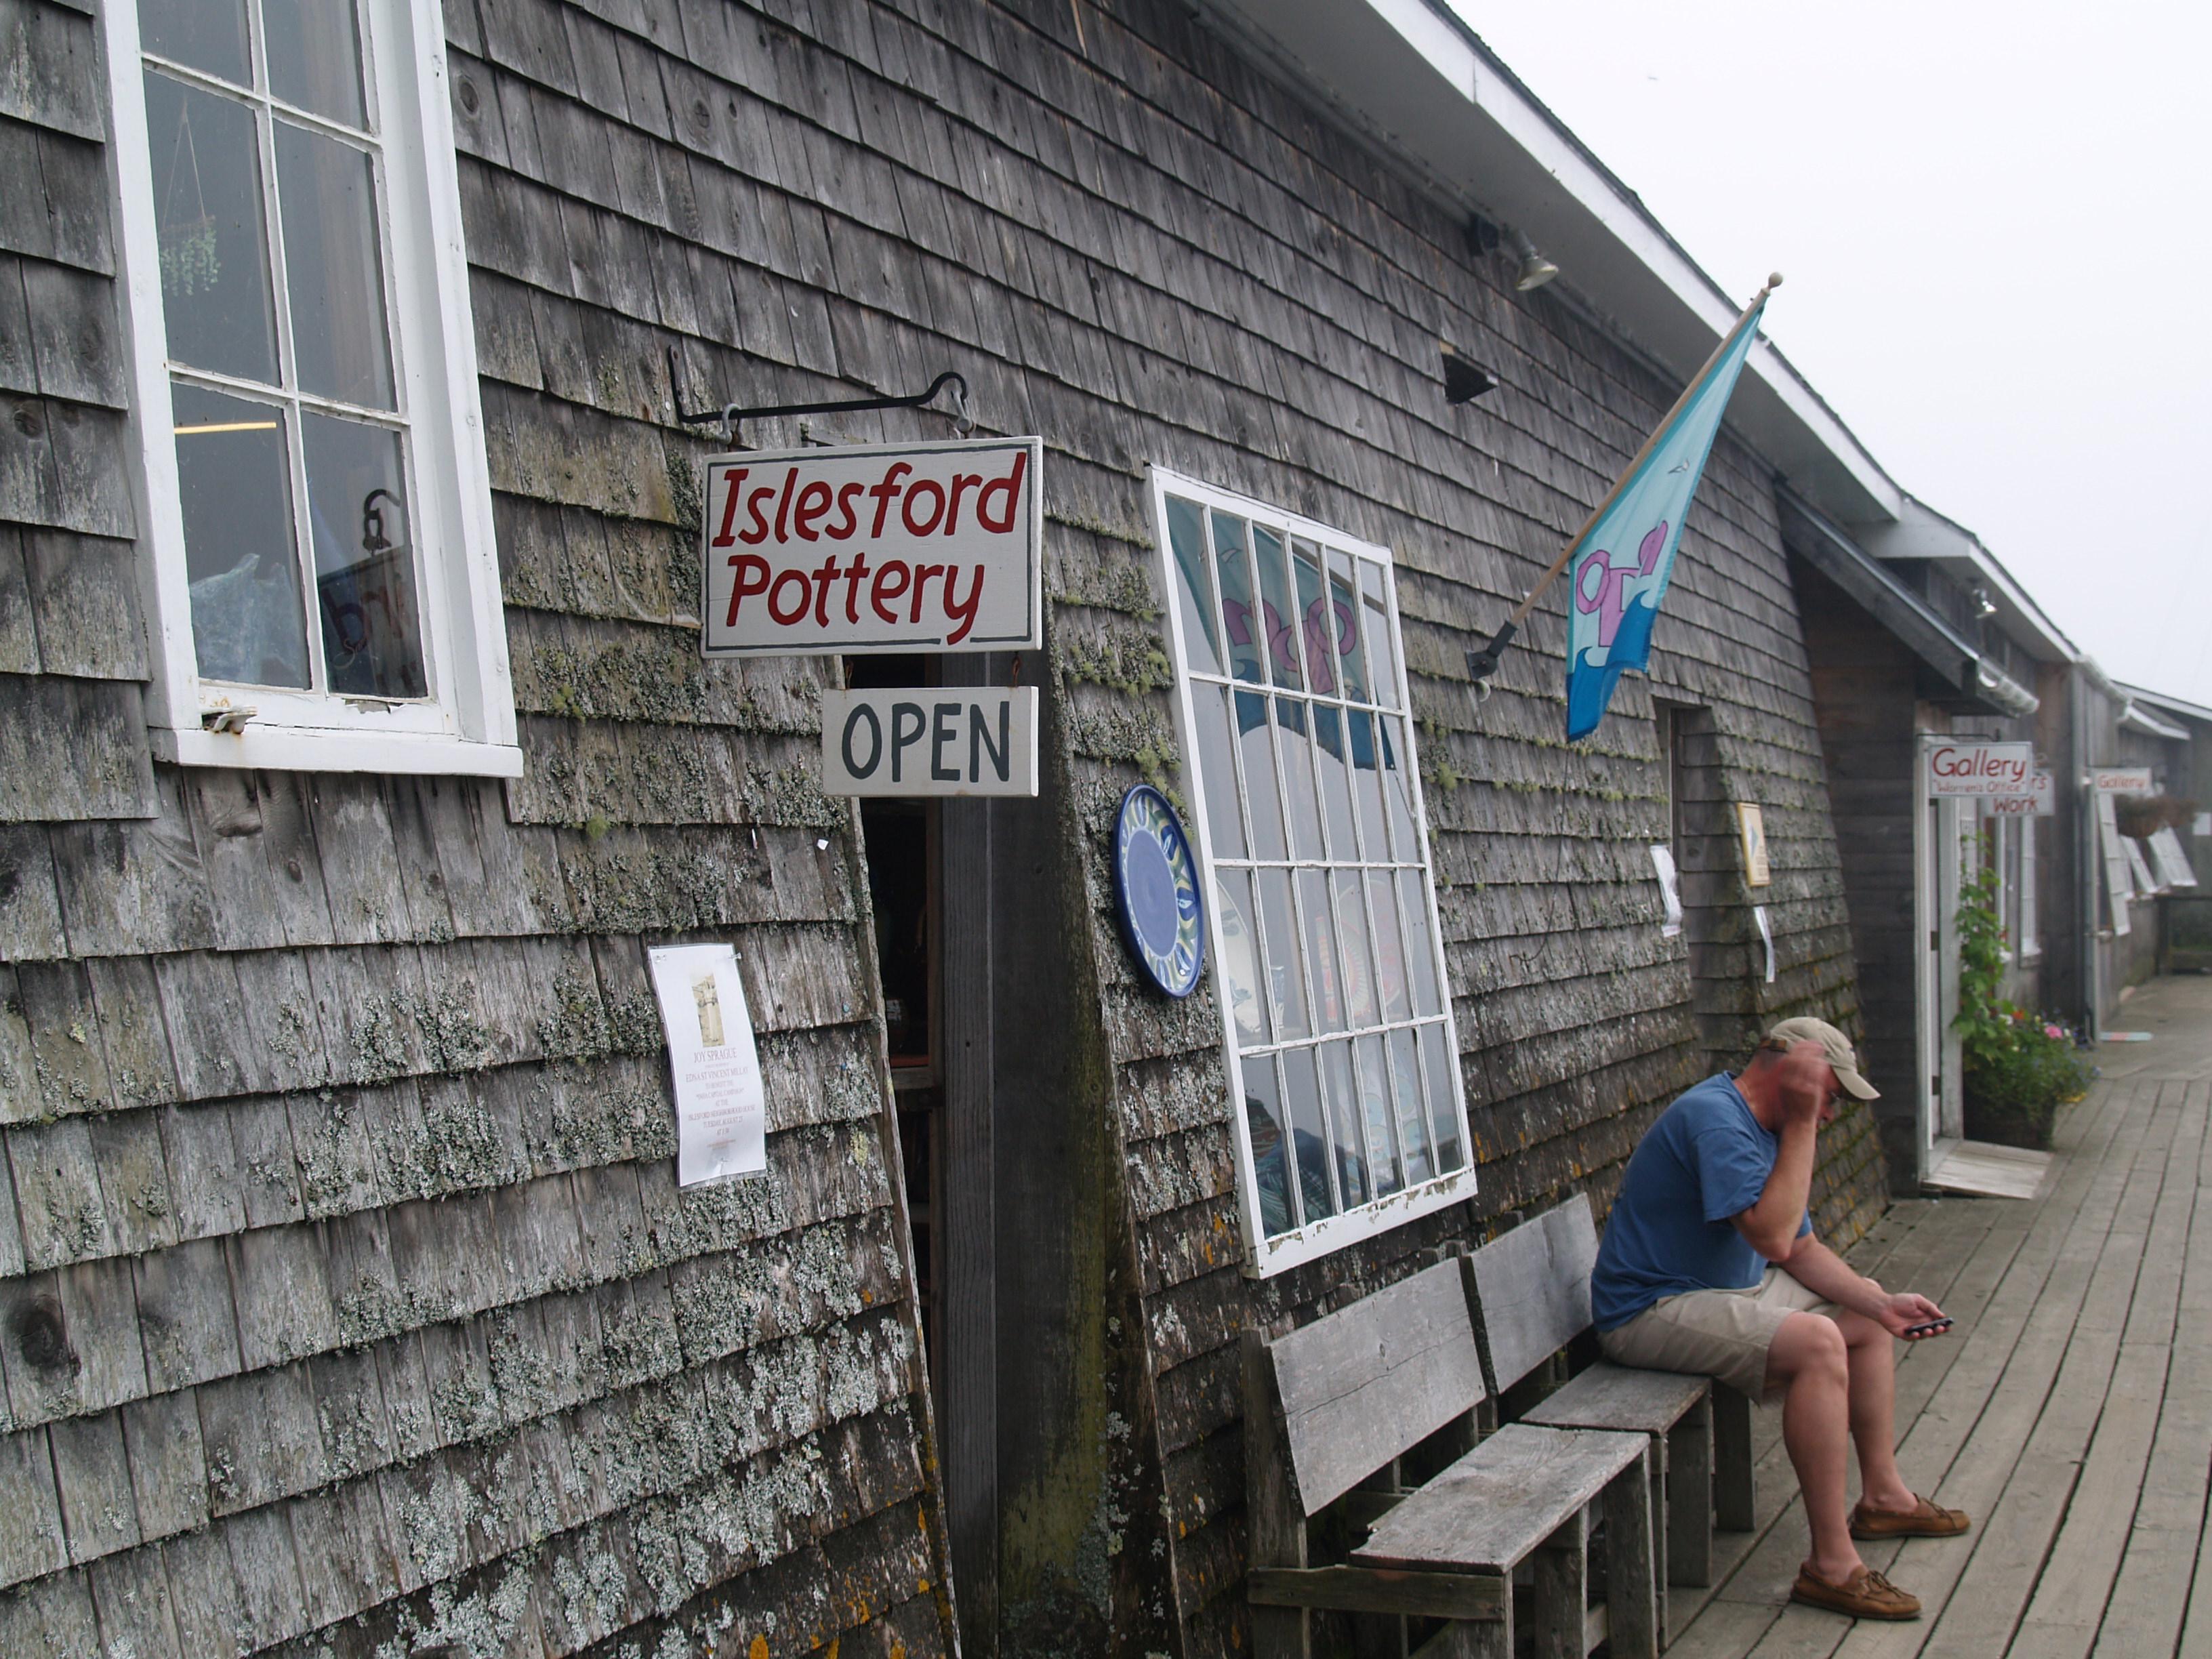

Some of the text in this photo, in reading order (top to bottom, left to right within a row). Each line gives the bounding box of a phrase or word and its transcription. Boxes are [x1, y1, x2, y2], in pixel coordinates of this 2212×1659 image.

[712, 452, 1027, 547] Islesford
[726, 552, 985, 645] Pottery
[842, 701, 1010, 782] OPEN
[1933, 747, 2026, 782] Gallery
[1993, 796, 2037, 813] Work
[2097, 774, 2145, 789] Gallery
